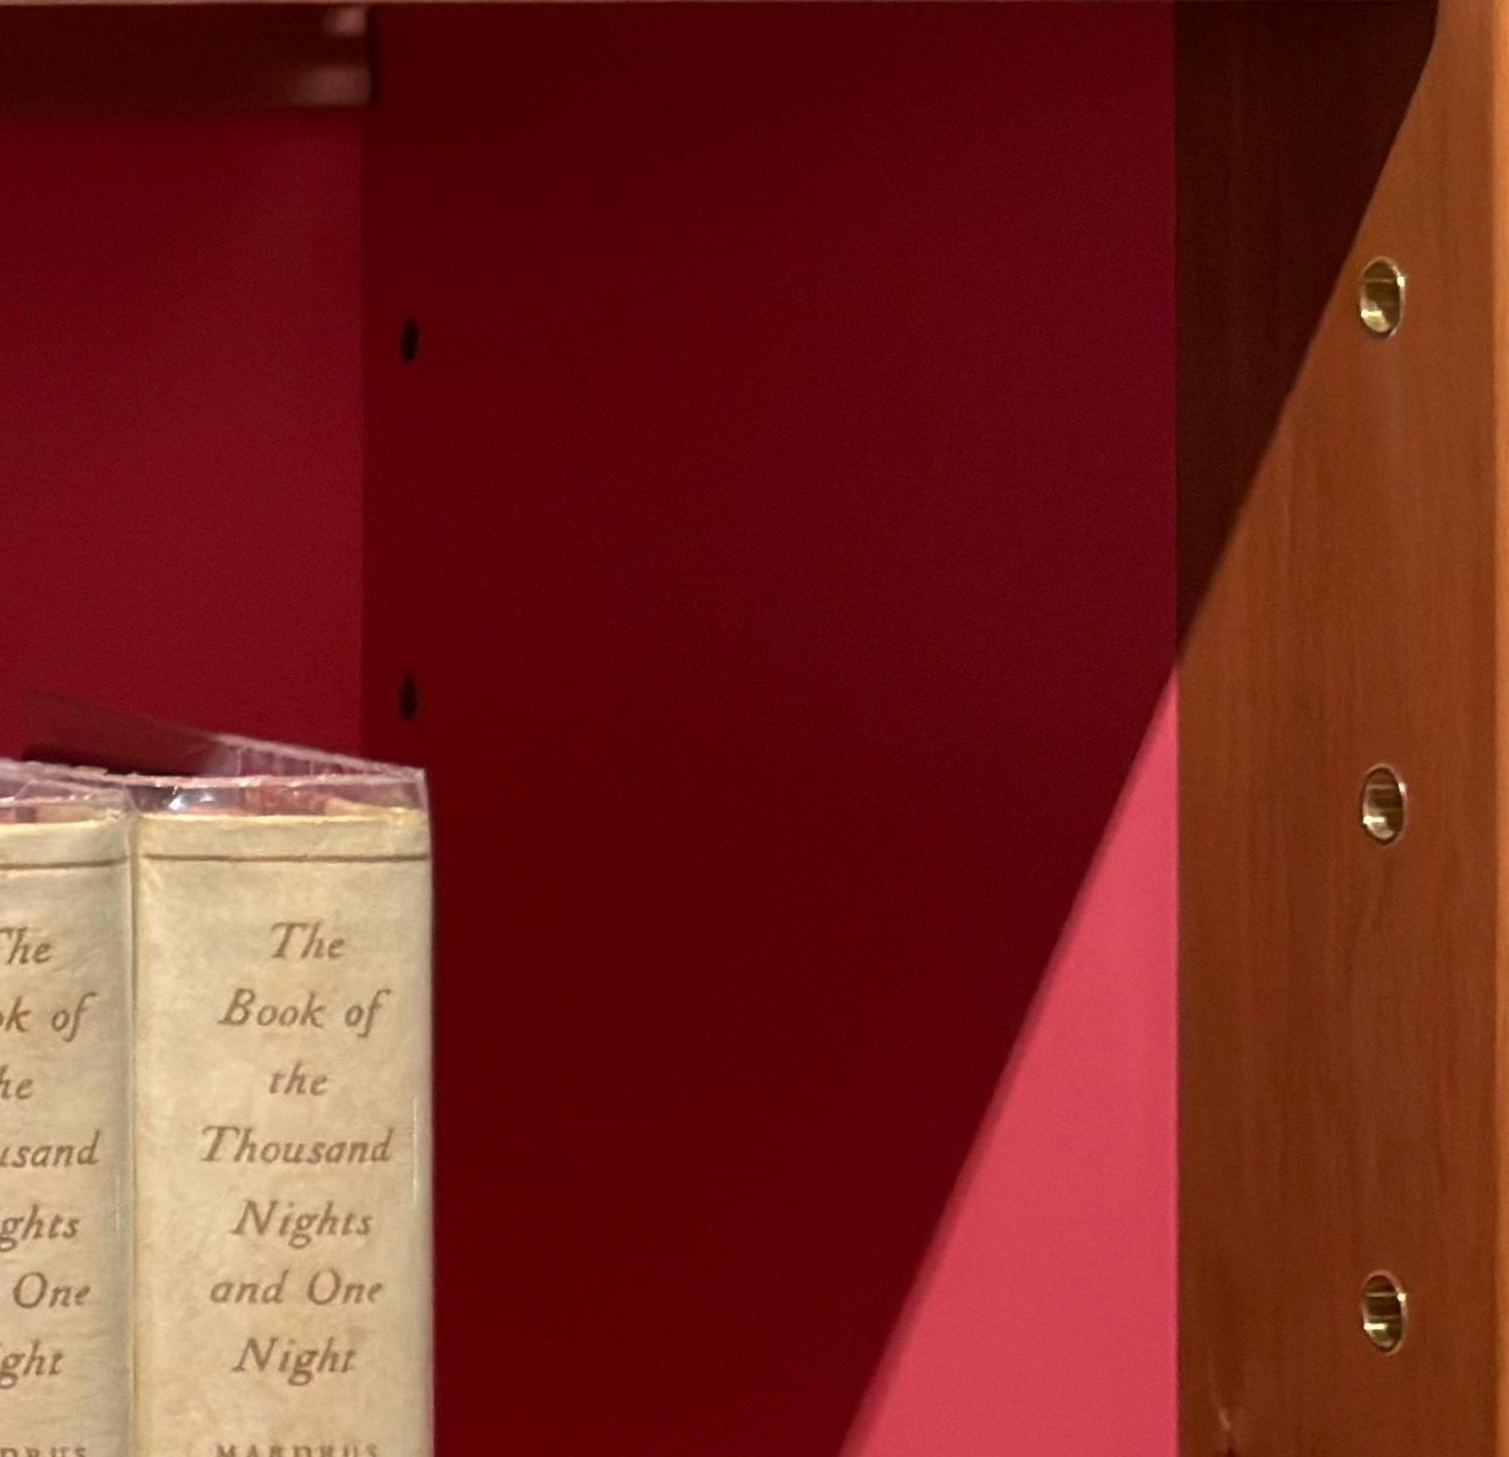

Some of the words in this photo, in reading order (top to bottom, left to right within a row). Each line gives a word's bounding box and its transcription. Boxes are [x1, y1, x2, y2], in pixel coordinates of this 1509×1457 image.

[271, 921, 345, 960] The
[52, 992, 98, 1043] of
[218, 988, 325, 1028] Book
[345, 989, 392, 1038] of
[269, 1060, 328, 1096] the
[201, 1125, 394, 1164] Thousand
[230, 1200, 372, 1249] Nights
[13, 1272, 91, 1309] One
[210, 1268, 290, 1305] and
[306, 1268, 384, 1306] One
[231, 1336, 357, 1386] Night
